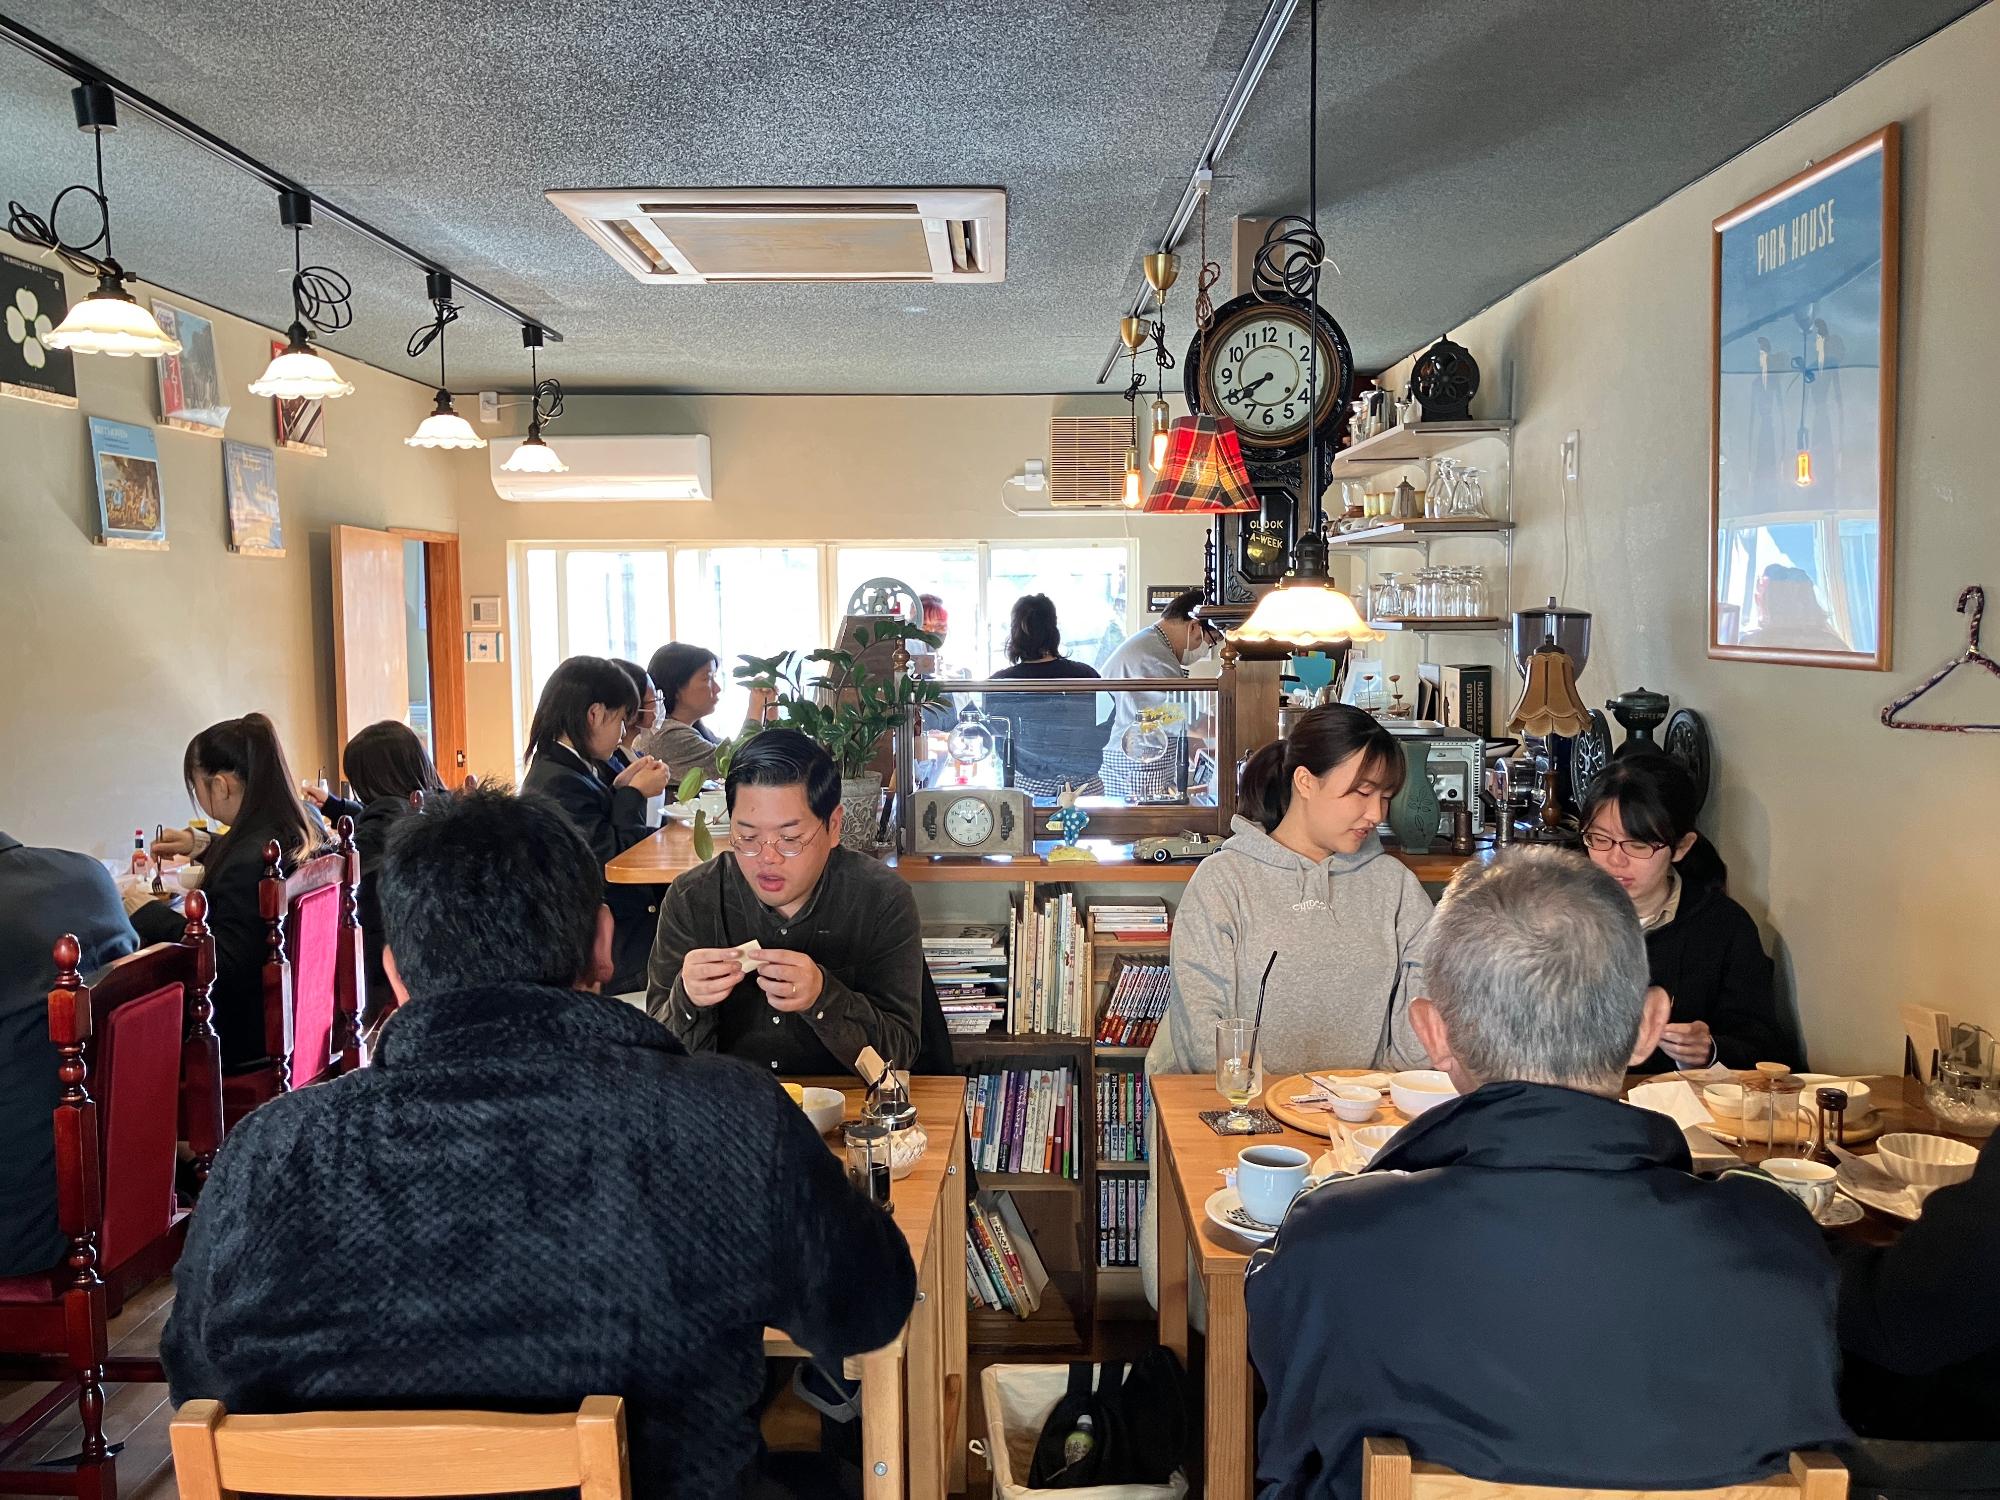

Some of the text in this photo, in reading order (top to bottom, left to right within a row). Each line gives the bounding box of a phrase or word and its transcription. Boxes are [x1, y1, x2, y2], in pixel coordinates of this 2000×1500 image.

[1757, 198, 1835, 276] PINK HOUSE
[1245, 332, 1256, 349] 11
[1262, 326, 1277, 343] 12
[1288, 332, 1293, 348] 1
[1229, 346, 1244, 363] 10
[1299, 345, 1310, 361] 2
[1221, 367, 1232, 385] 9
[1297, 388, 1310, 404] 4
[1244, 404, 1257, 420] 7
[1262, 408, 1274, 425] 6
[1283, 403, 1294, 419] 5
